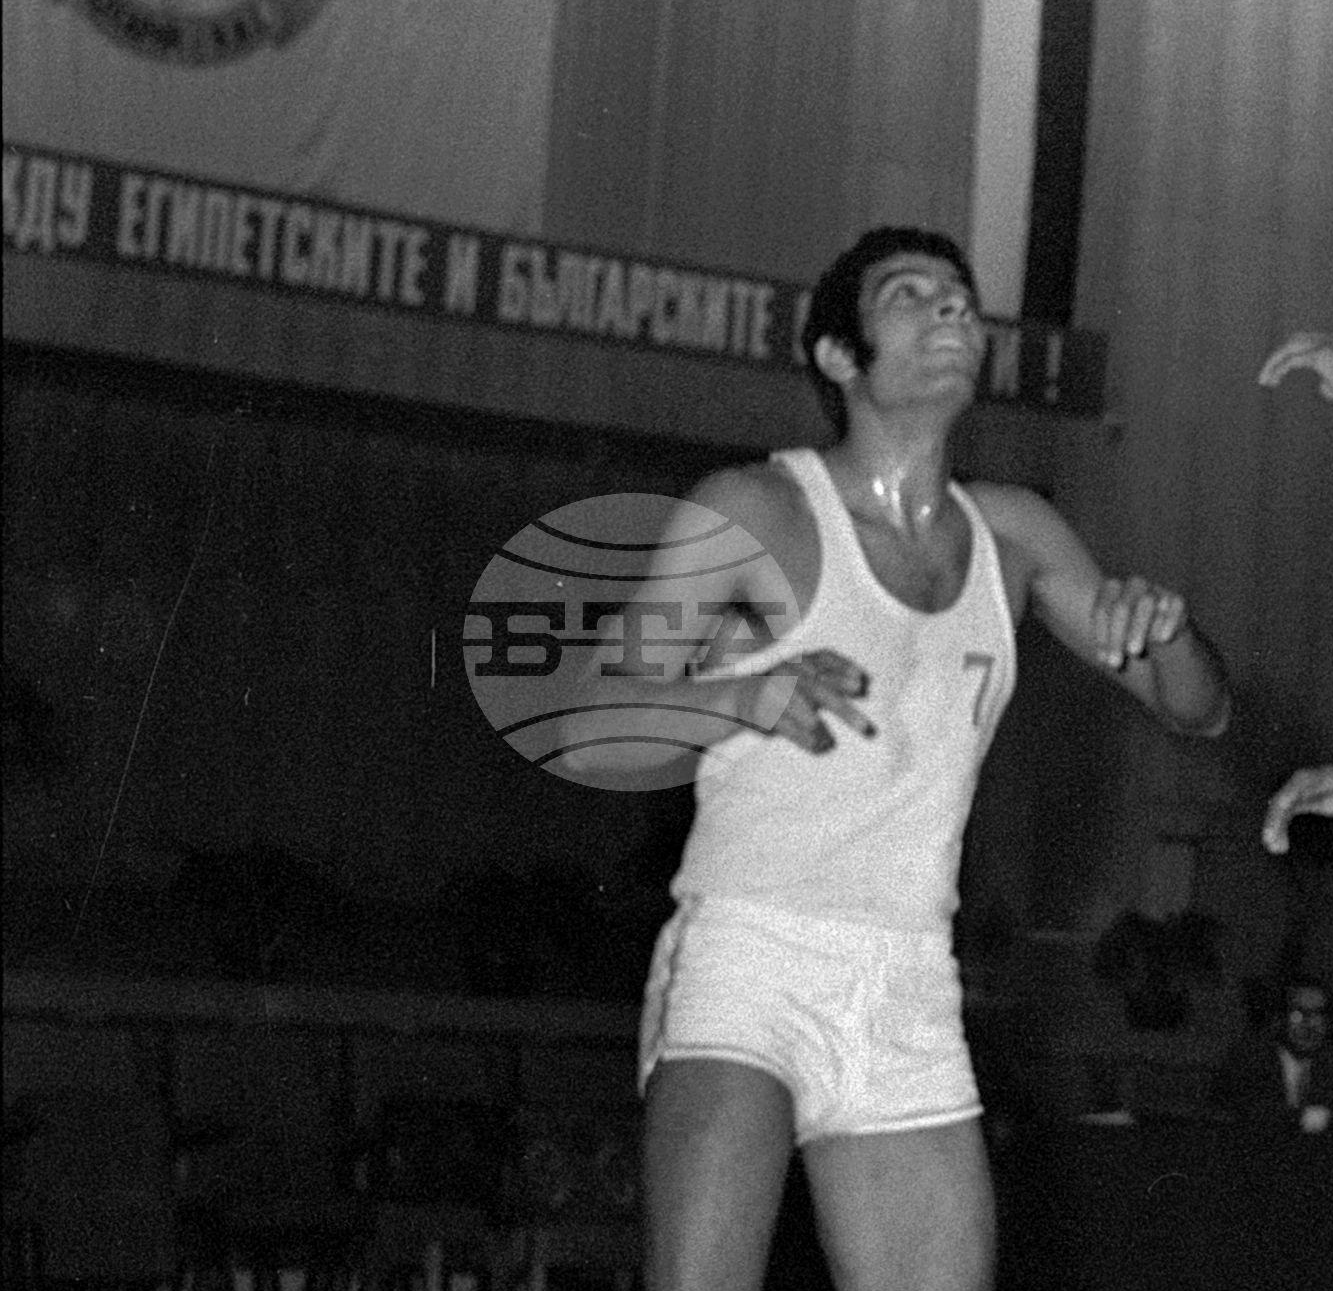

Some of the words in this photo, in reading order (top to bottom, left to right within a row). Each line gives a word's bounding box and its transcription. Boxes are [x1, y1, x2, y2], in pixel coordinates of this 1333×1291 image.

[115, 171, 431, 306] ЕГИПЕТСКИТЕ
[443, 232, 481, 314] И
[500, 243, 775, 358] БЪЛГАРСКИТЕ
[962, 651, 996, 728] 7
